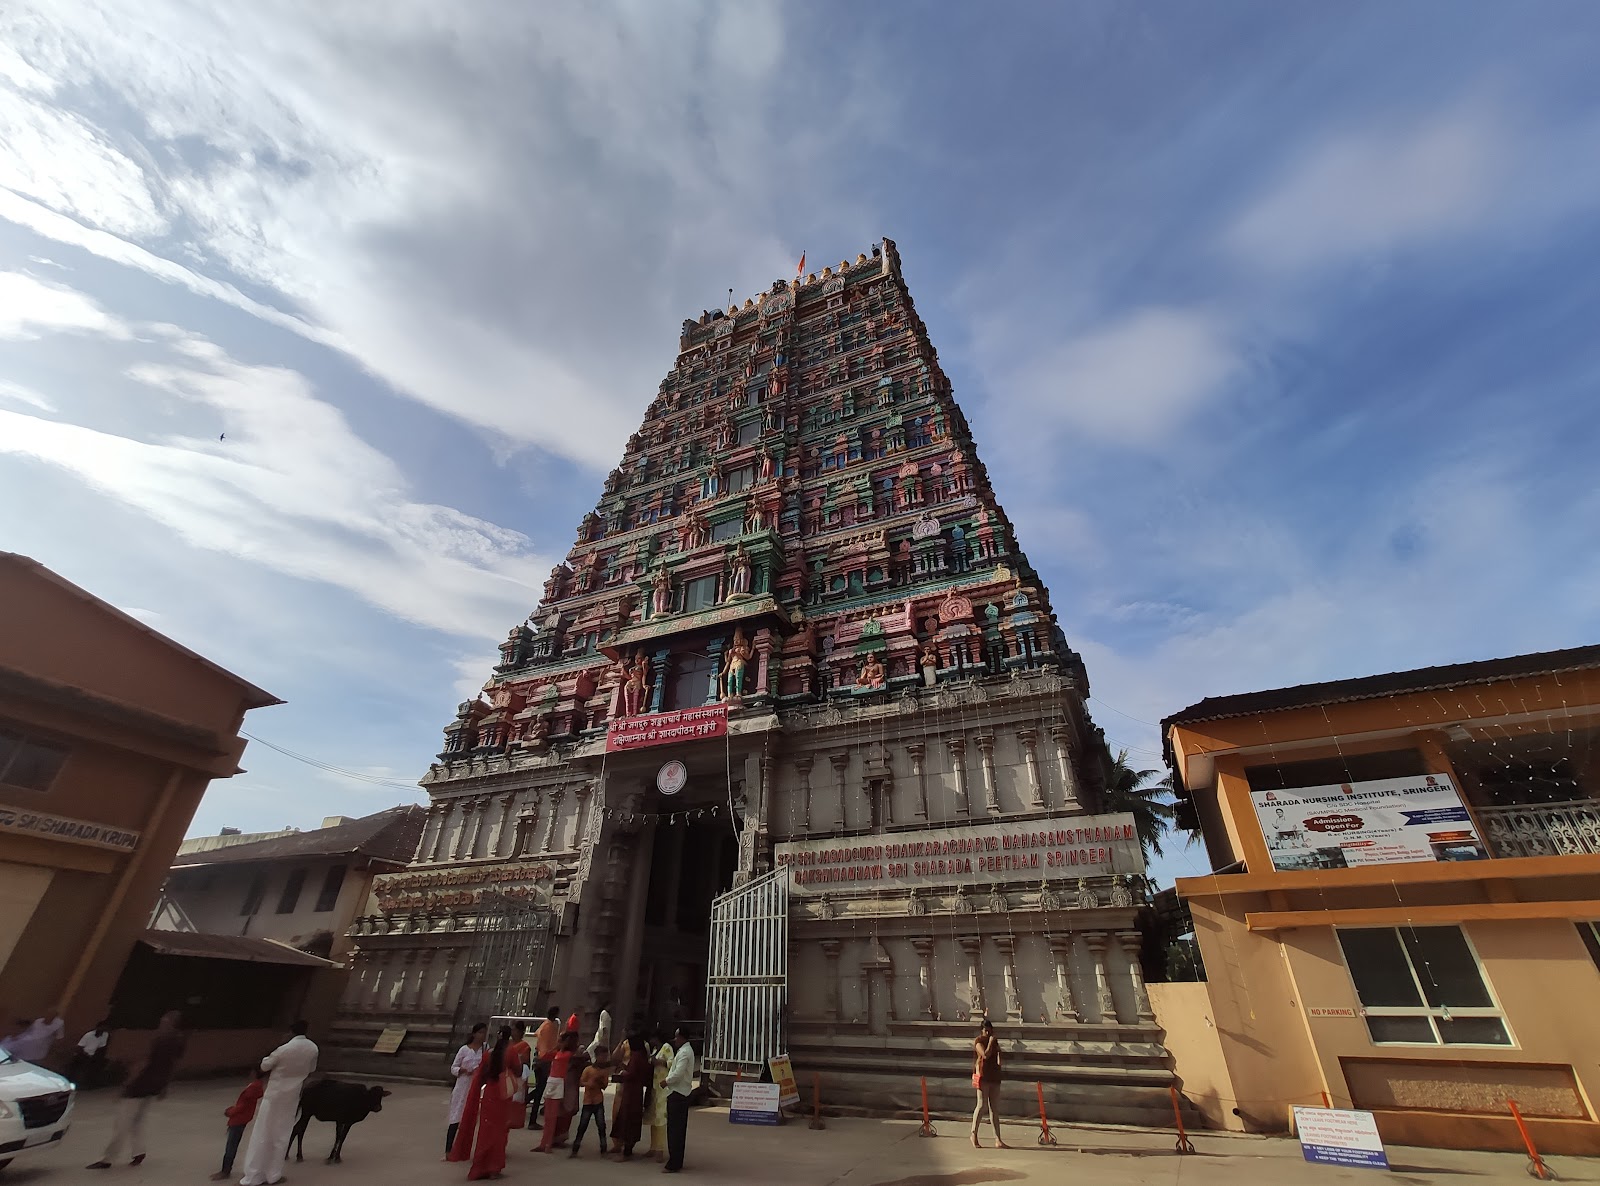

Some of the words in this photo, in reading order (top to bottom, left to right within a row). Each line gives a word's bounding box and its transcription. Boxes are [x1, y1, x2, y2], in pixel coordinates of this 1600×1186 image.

[618, 721, 627, 731] श्री
[682, 708, 725, 721] महासंस्थानम्
[647, 729, 657, 740] श्री
[1259, 799, 1300, 808] SHARADA
[1303, 795, 1344, 804] NURSING
[1347, 790, 1401, 800] INSTITUTE,
[1402, 785, 1451, 795] SRINGERI
[17, 814, 41, 830] SRI
[41, 818, 100, 840] SHARADA
[100, 829, 137, 848] KRUPA
[1313, 817, 1353, 825] Admission
[1325, 823, 1346, 831] Open
[777, 853, 795, 866] SRI
[797, 851, 816, 866] SRI
[817, 845, 882, 864] JAGADGURU
[885, 836, 998, 859] SHANKARACHARYA
[1002, 824, 1134, 849] MAHASAMSTHANAM
[888, 862, 908, 878] SRI
[913, 857, 971, 876] SHARADA
[978, 853, 1040, 872] PEETHAM
[1046, 847, 1114, 867] SRINGERI
